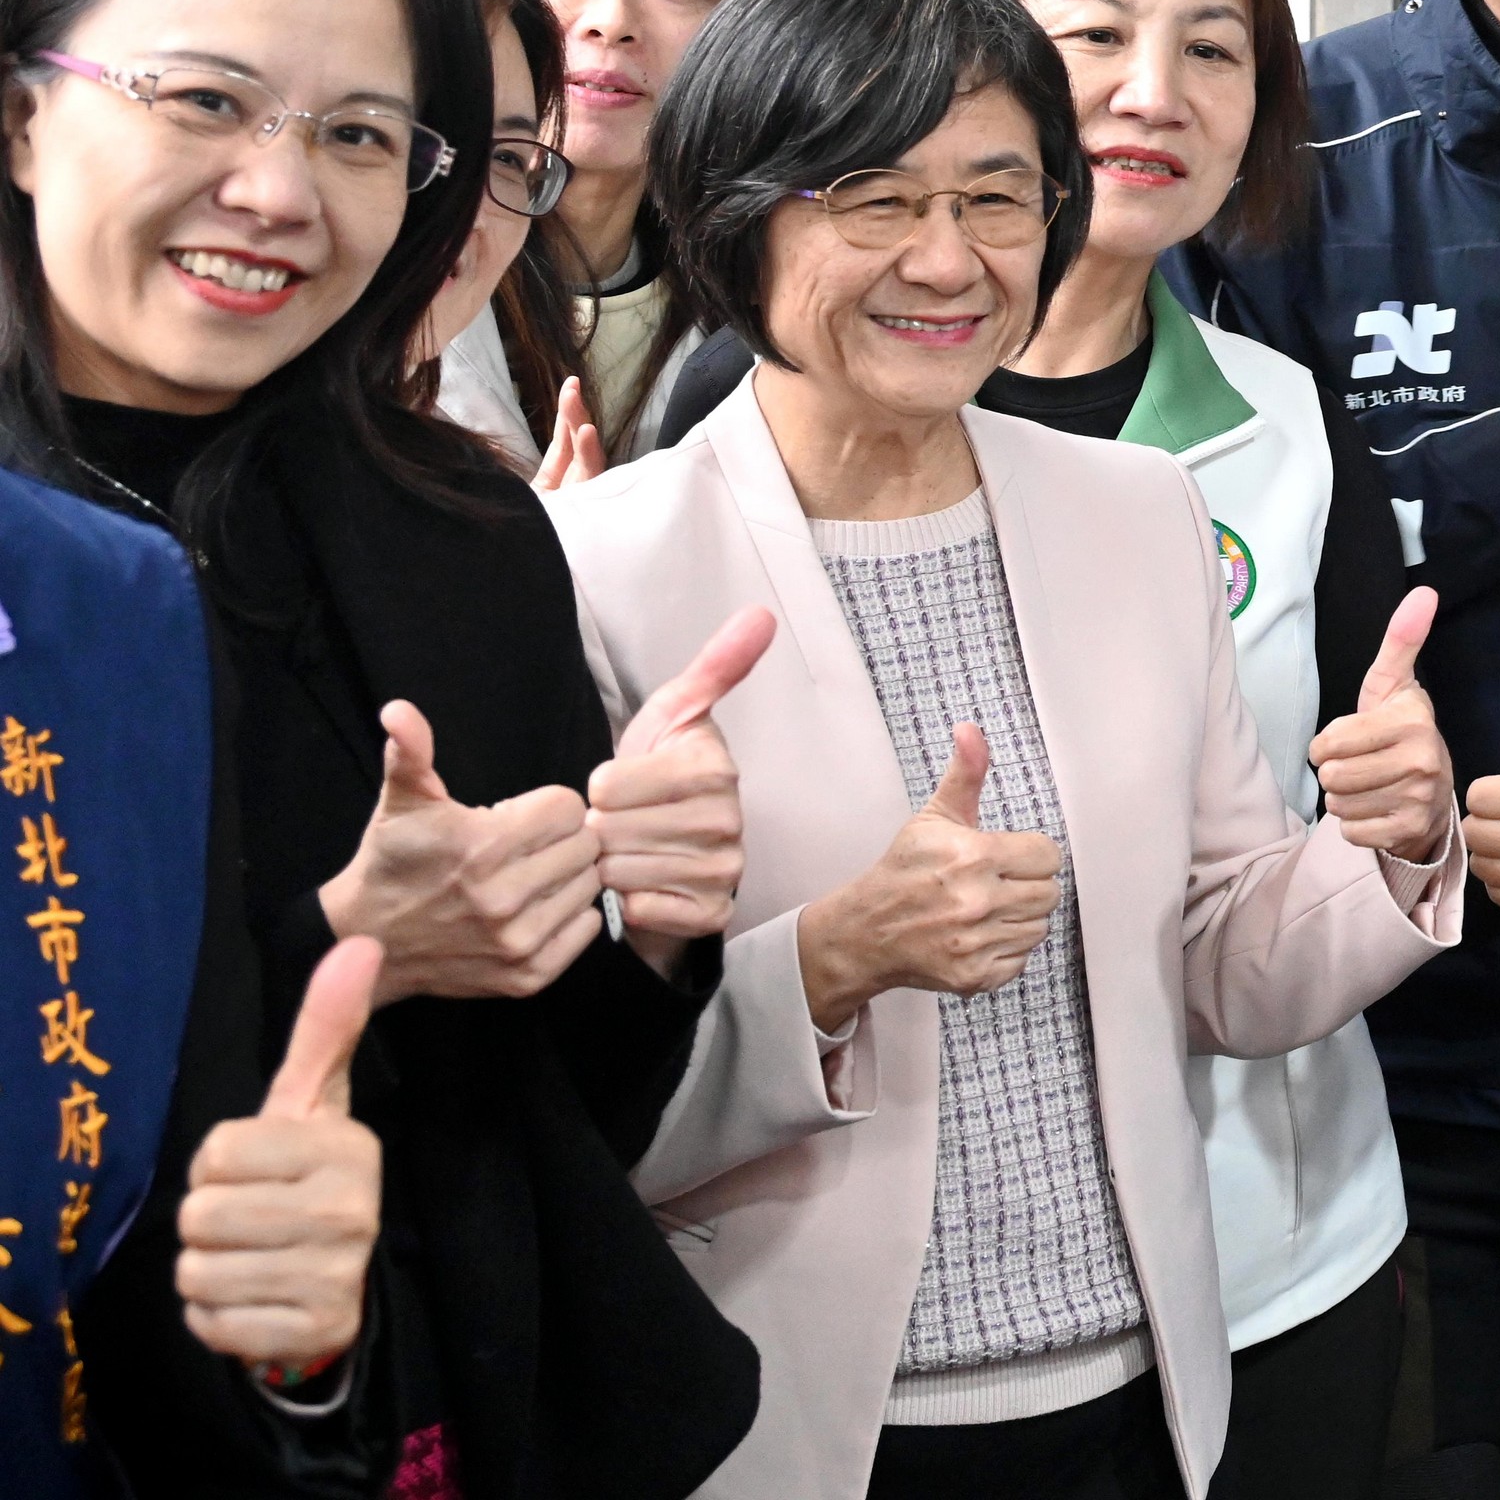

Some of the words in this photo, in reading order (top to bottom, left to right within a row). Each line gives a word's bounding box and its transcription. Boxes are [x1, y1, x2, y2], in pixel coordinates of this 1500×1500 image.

[1343, 385, 1467, 411] 新北市政府
